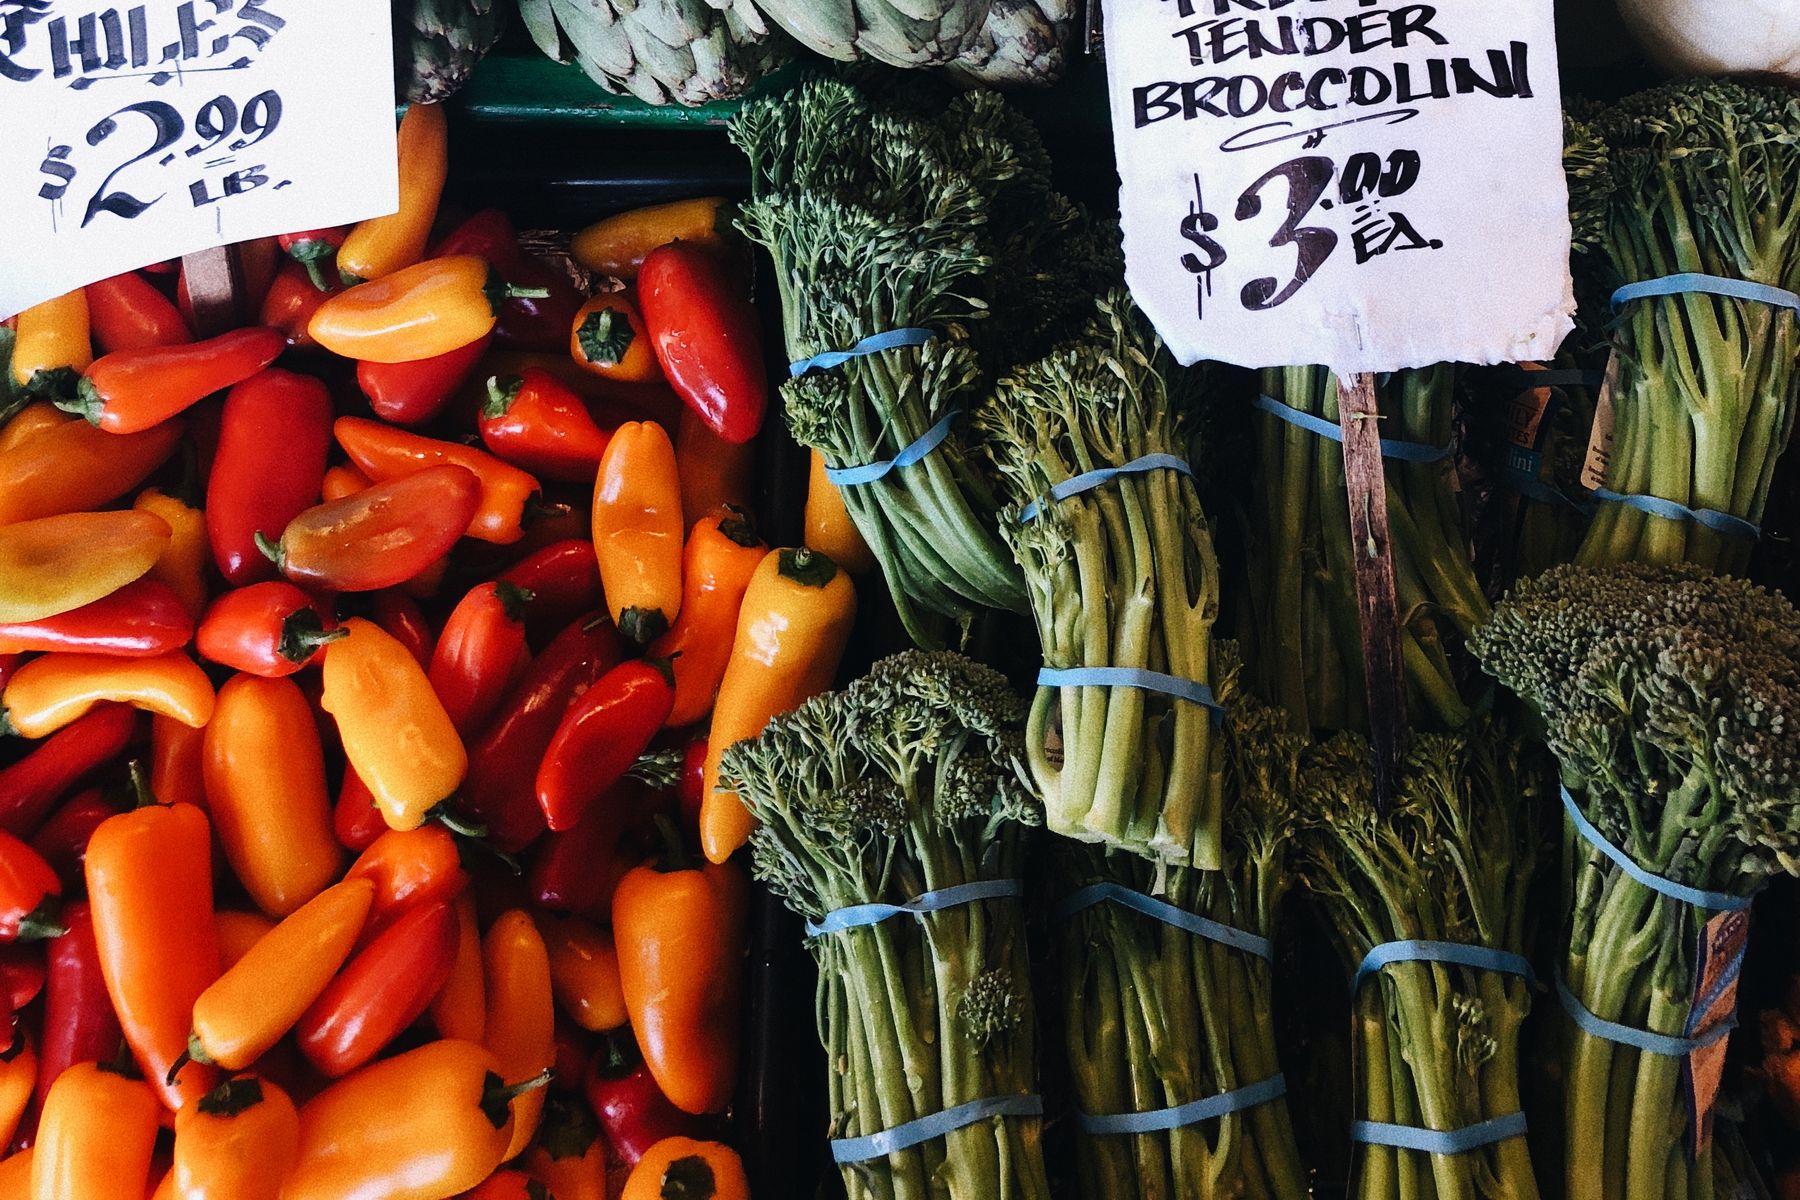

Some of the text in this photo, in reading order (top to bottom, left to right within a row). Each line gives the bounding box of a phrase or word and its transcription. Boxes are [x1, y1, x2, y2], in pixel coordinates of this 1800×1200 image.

[1172, 4, 1450, 66] TENDER
[1132, 40, 1534, 129] BROCCOLINI
[38, 89, 283, 233] $2.99
[189, 164, 292, 208] LB.
[1180, 148, 1421, 321] $3.00
[1350, 210, 1444, 265] EA.
